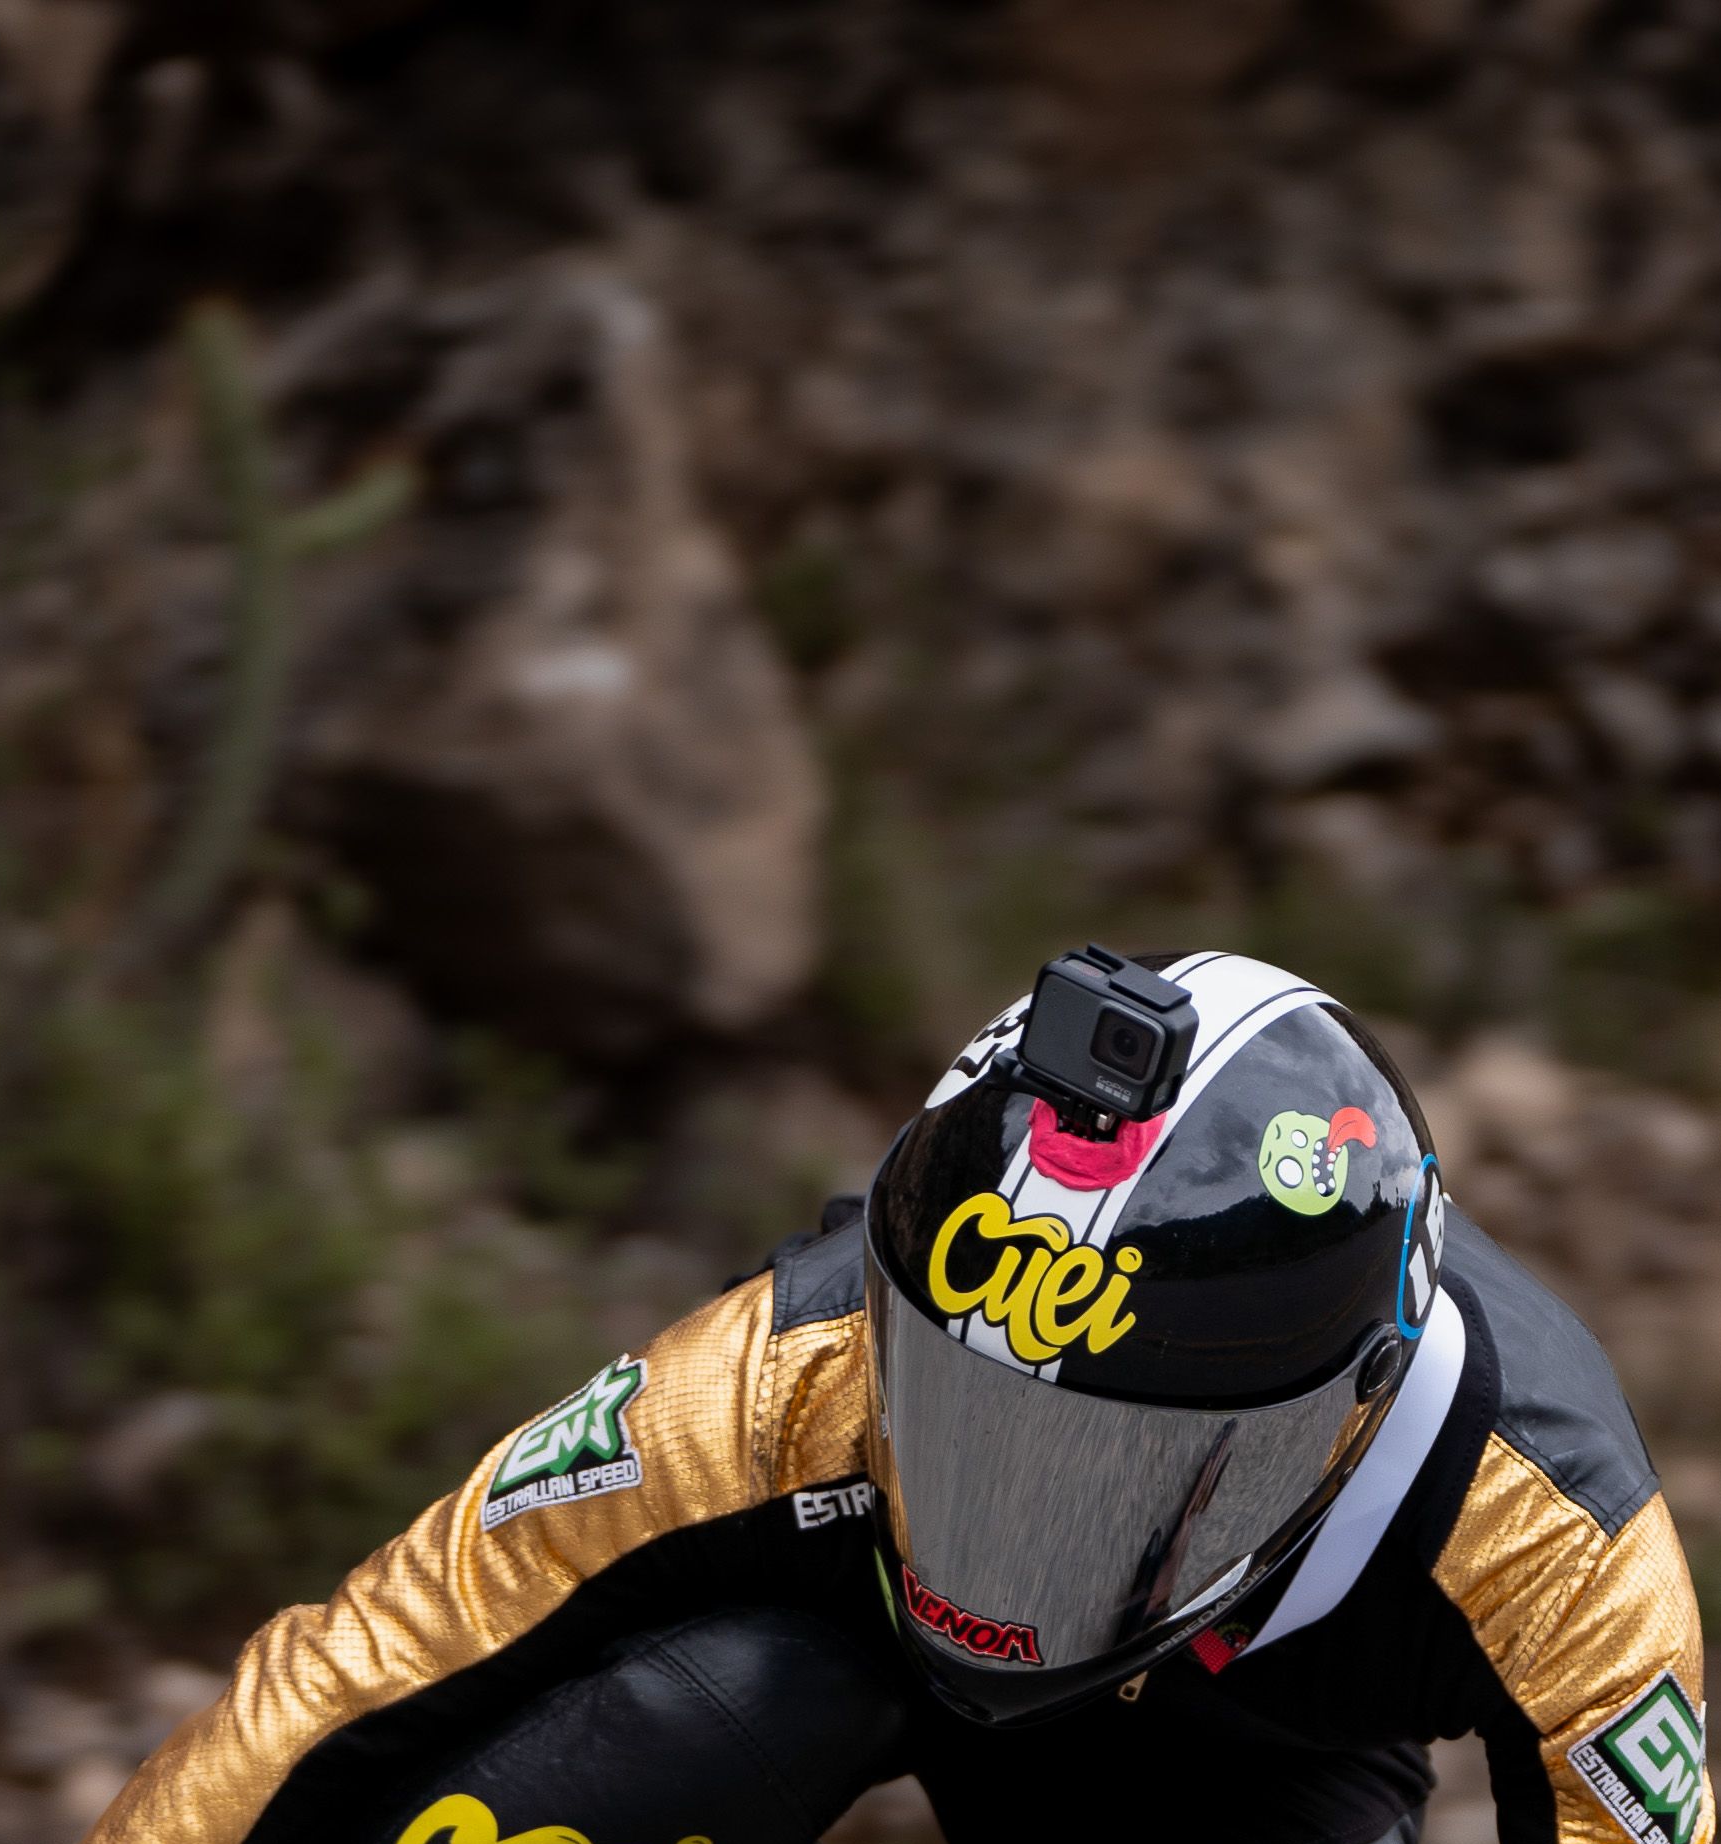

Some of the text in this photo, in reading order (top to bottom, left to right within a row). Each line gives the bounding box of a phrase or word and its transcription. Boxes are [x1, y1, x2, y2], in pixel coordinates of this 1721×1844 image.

[1096, 1075, 1133, 1098] GoPro
[929, 1191, 1143, 1361] Cuei
[485, 1459, 639, 1524] ESTRALLAN SPEED
[902, 1563, 1042, 1664] VENOM
[1156, 1564, 1268, 1653] PREDATOR
[1578, 1743, 1654, 1834] ESTRALLAN
